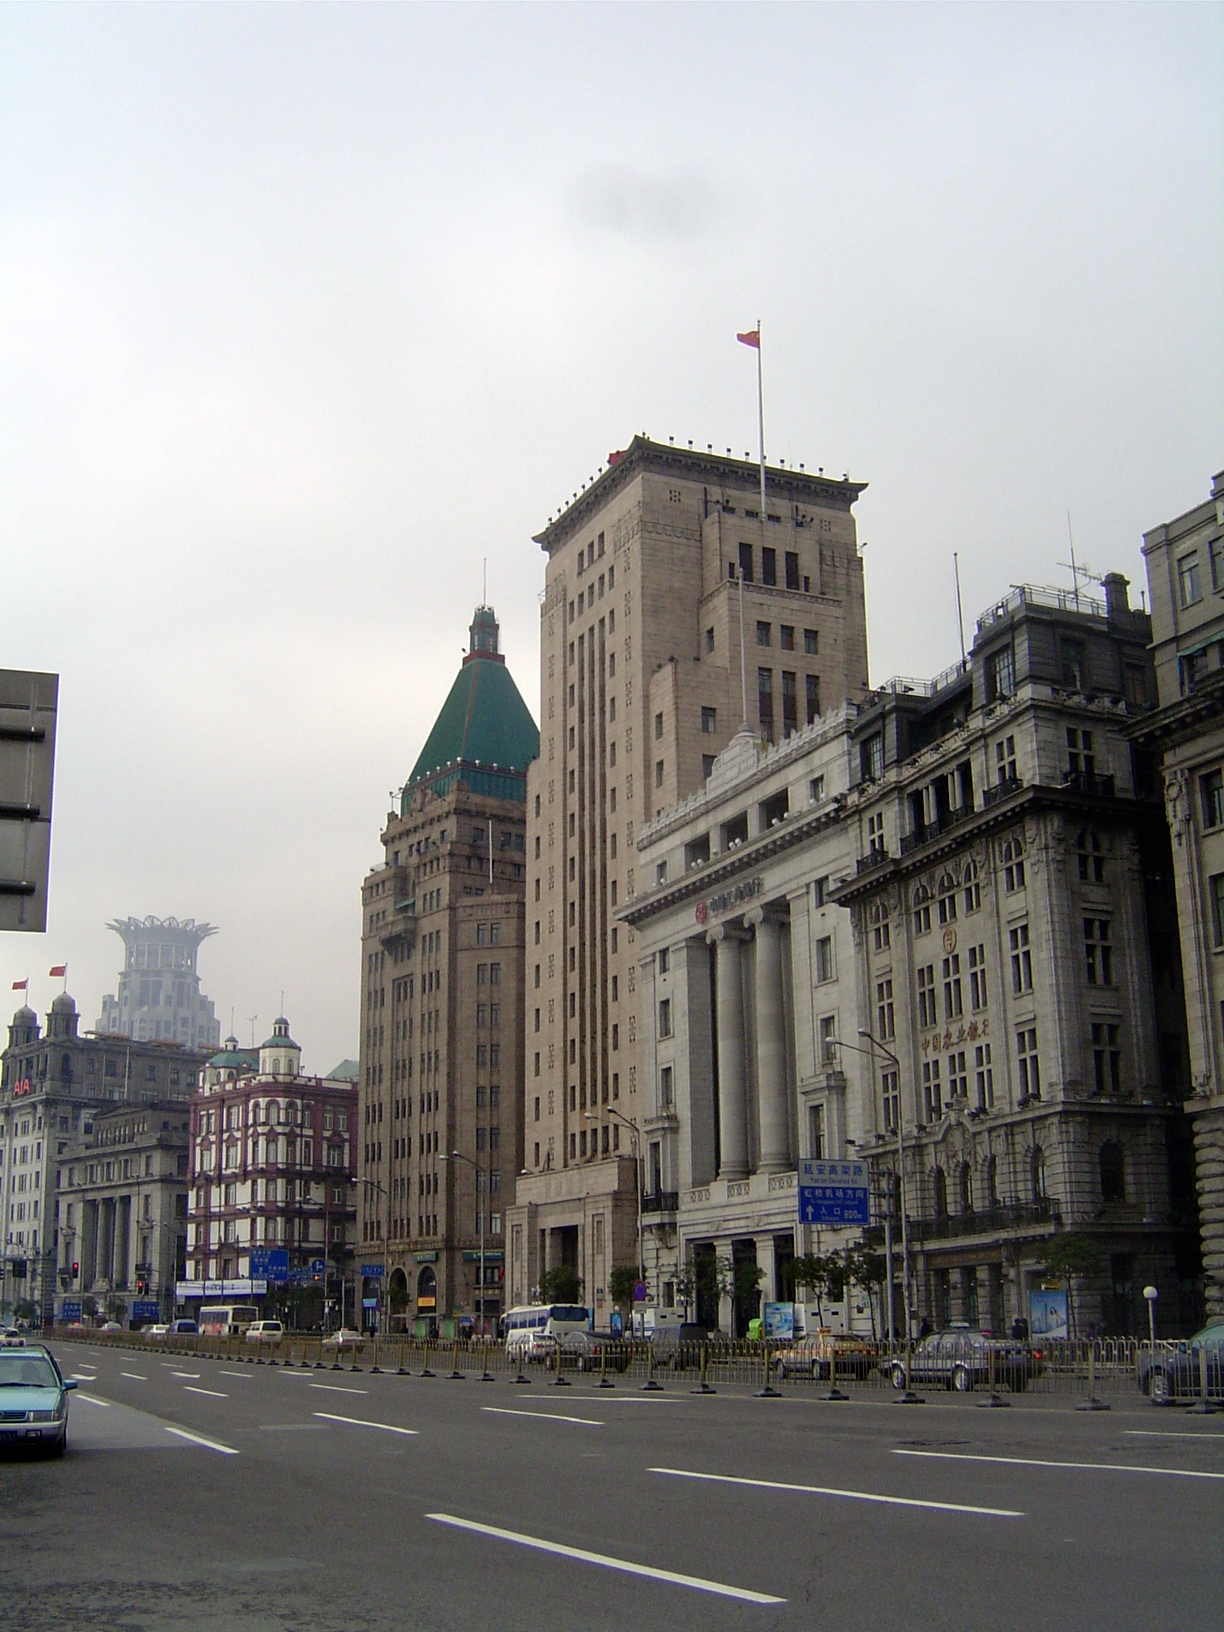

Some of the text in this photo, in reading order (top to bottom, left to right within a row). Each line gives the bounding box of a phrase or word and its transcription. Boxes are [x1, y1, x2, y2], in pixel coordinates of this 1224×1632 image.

[921, 1018, 989, 1058] 中国农业银行
[13, 1078, 30, 1097] AIA
[804, 1164, 863, 1176] 延安高架路
[804, 1188, 864, 1198] 虹桥机场方向
